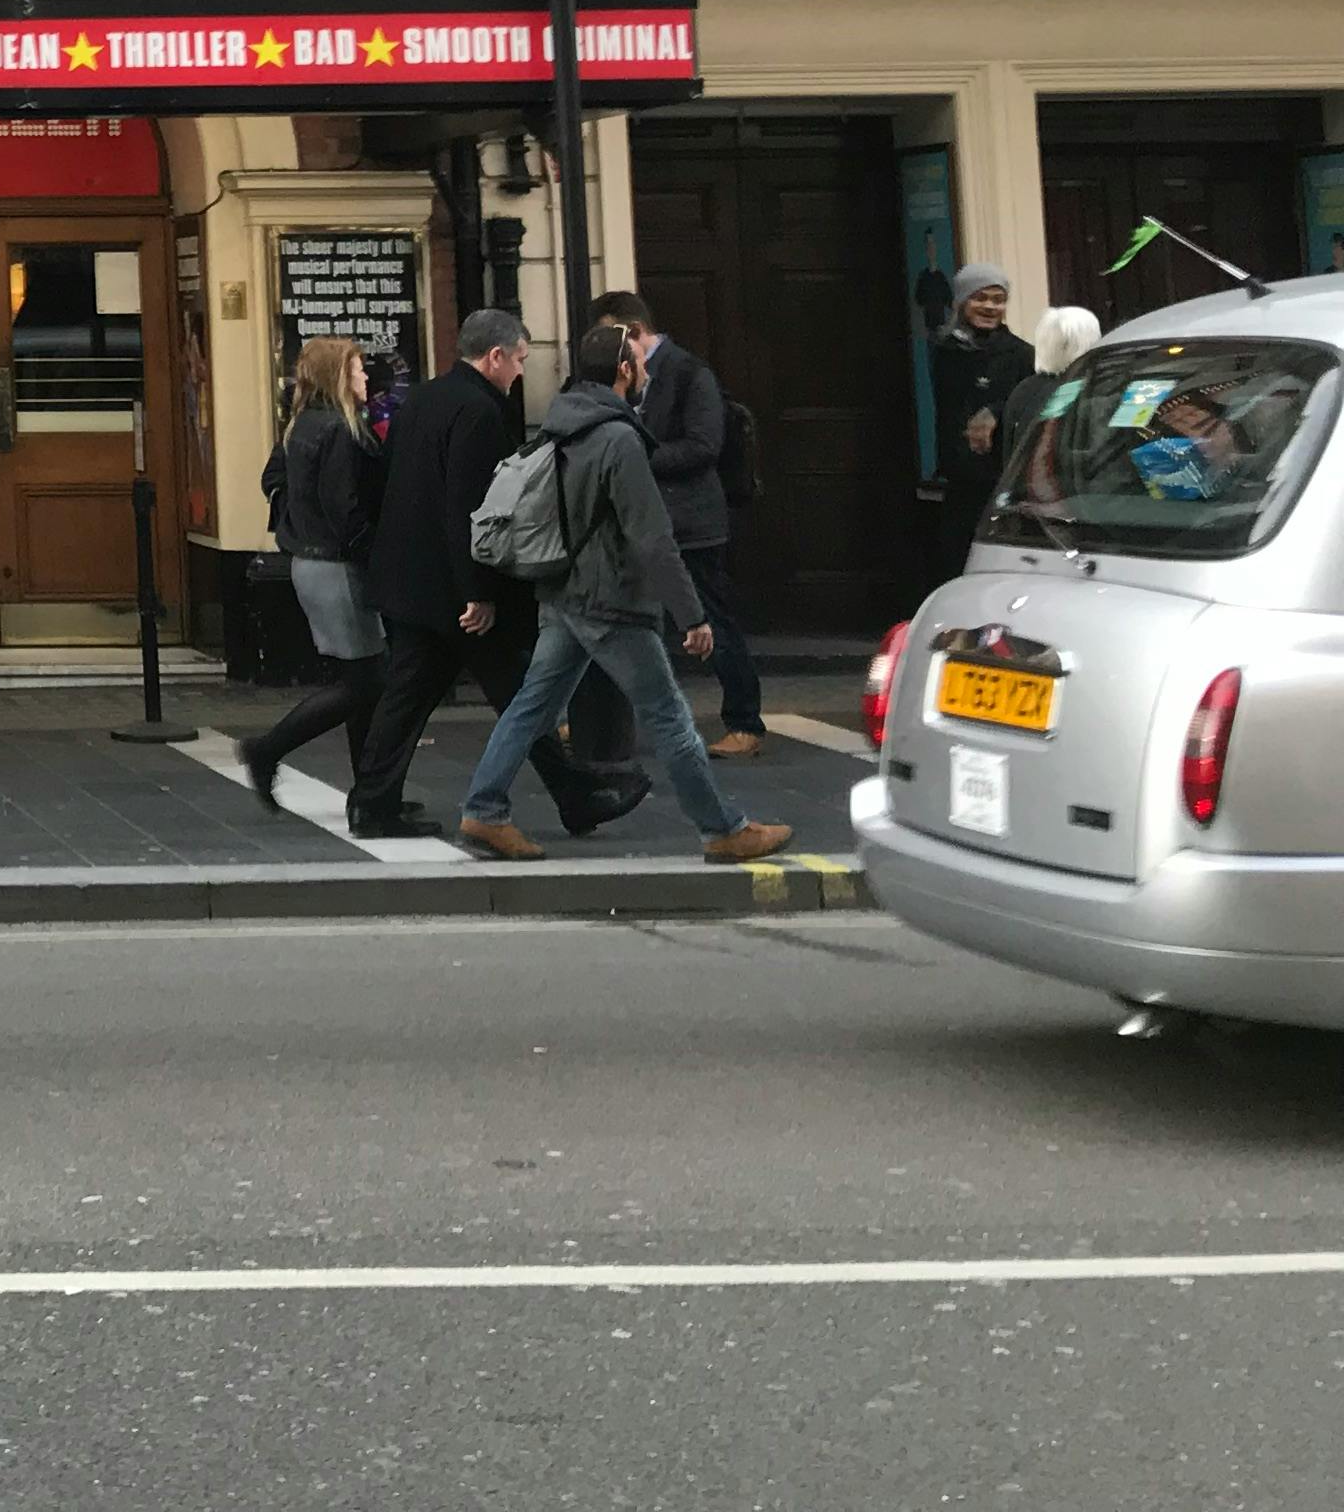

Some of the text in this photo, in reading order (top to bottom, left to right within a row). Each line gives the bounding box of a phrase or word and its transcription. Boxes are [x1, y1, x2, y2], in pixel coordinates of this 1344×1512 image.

[106, 30, 247, 69] THRILLER
[293, 28, 356, 66] BAD
[403, 25, 531, 63] SMOOTH
[337, 240, 378, 257] majesty
[381, 239, 393, 255] of
[288, 259, 404, 277] musical performance
[292, 279, 312, 294] will
[314, 280, 353, 294] ensure
[355, 279, 378, 294] that
[346, 298, 366, 314] will
[298, 318, 331, 335] Queen
[334, 319, 353, 334] and
